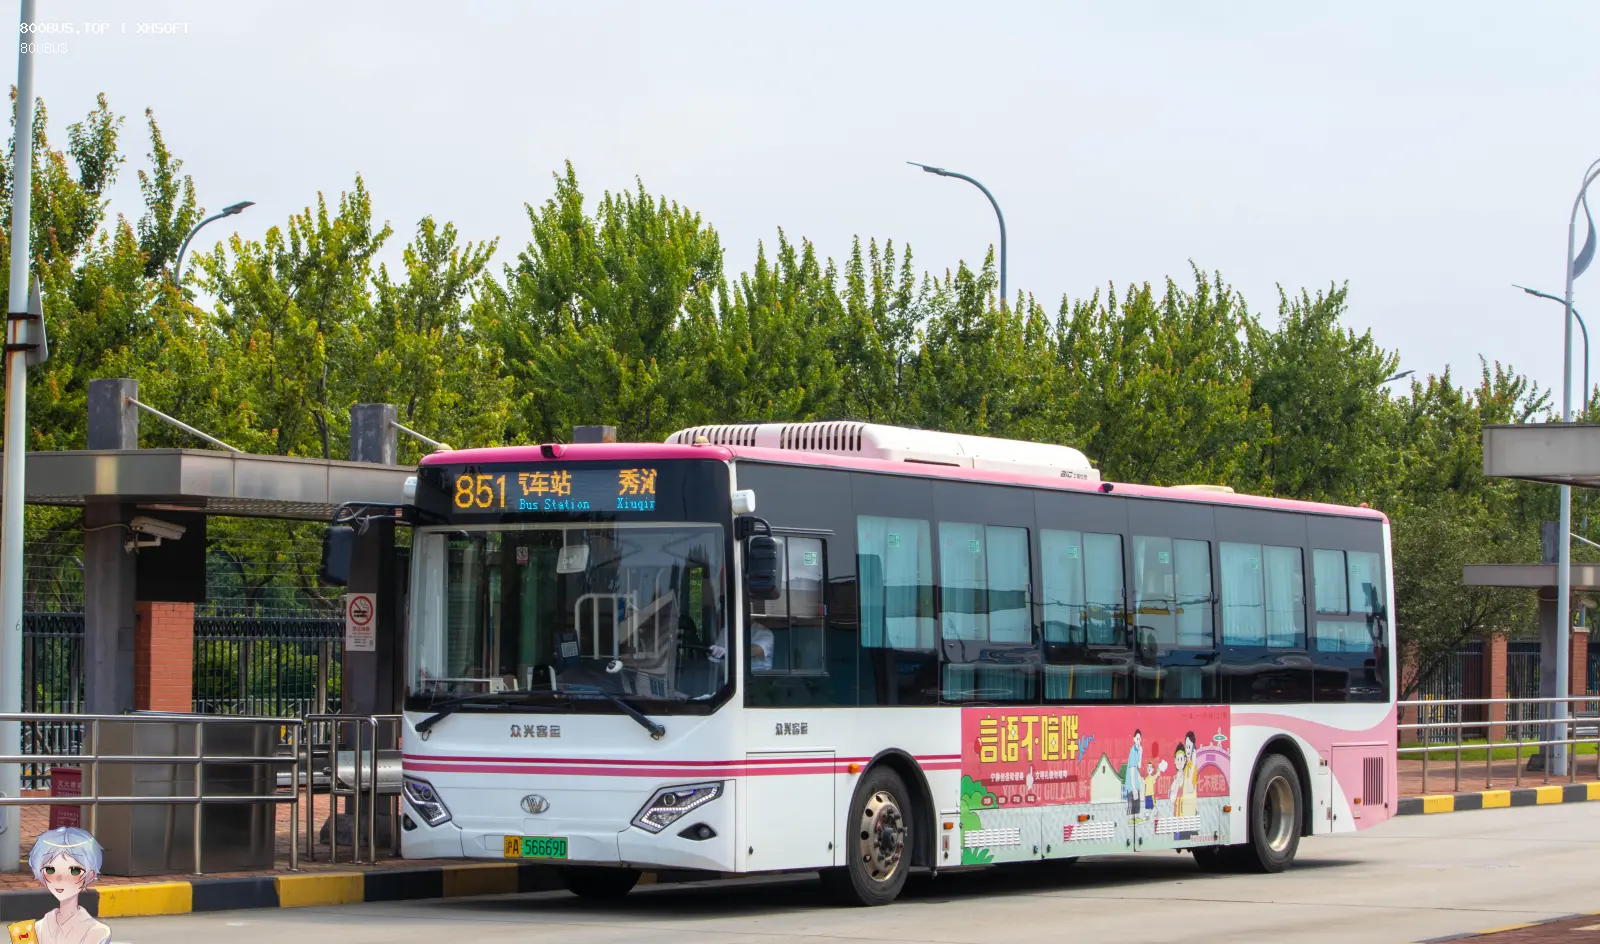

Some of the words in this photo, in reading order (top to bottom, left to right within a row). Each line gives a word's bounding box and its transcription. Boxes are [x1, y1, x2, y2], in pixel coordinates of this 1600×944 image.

[454, 474, 506, 508] 851
[519, 499, 538, 510] Bus
[544, 499, 590, 510] Station
[510, 724, 561, 738] 众兴客运
[775, 722, 808, 736] 众兴客运
[980, 712, 1079, 763] 言语不喧哗
[505, 838, 520, 855] 沪A
[524, 839, 567, 856] 56669D
